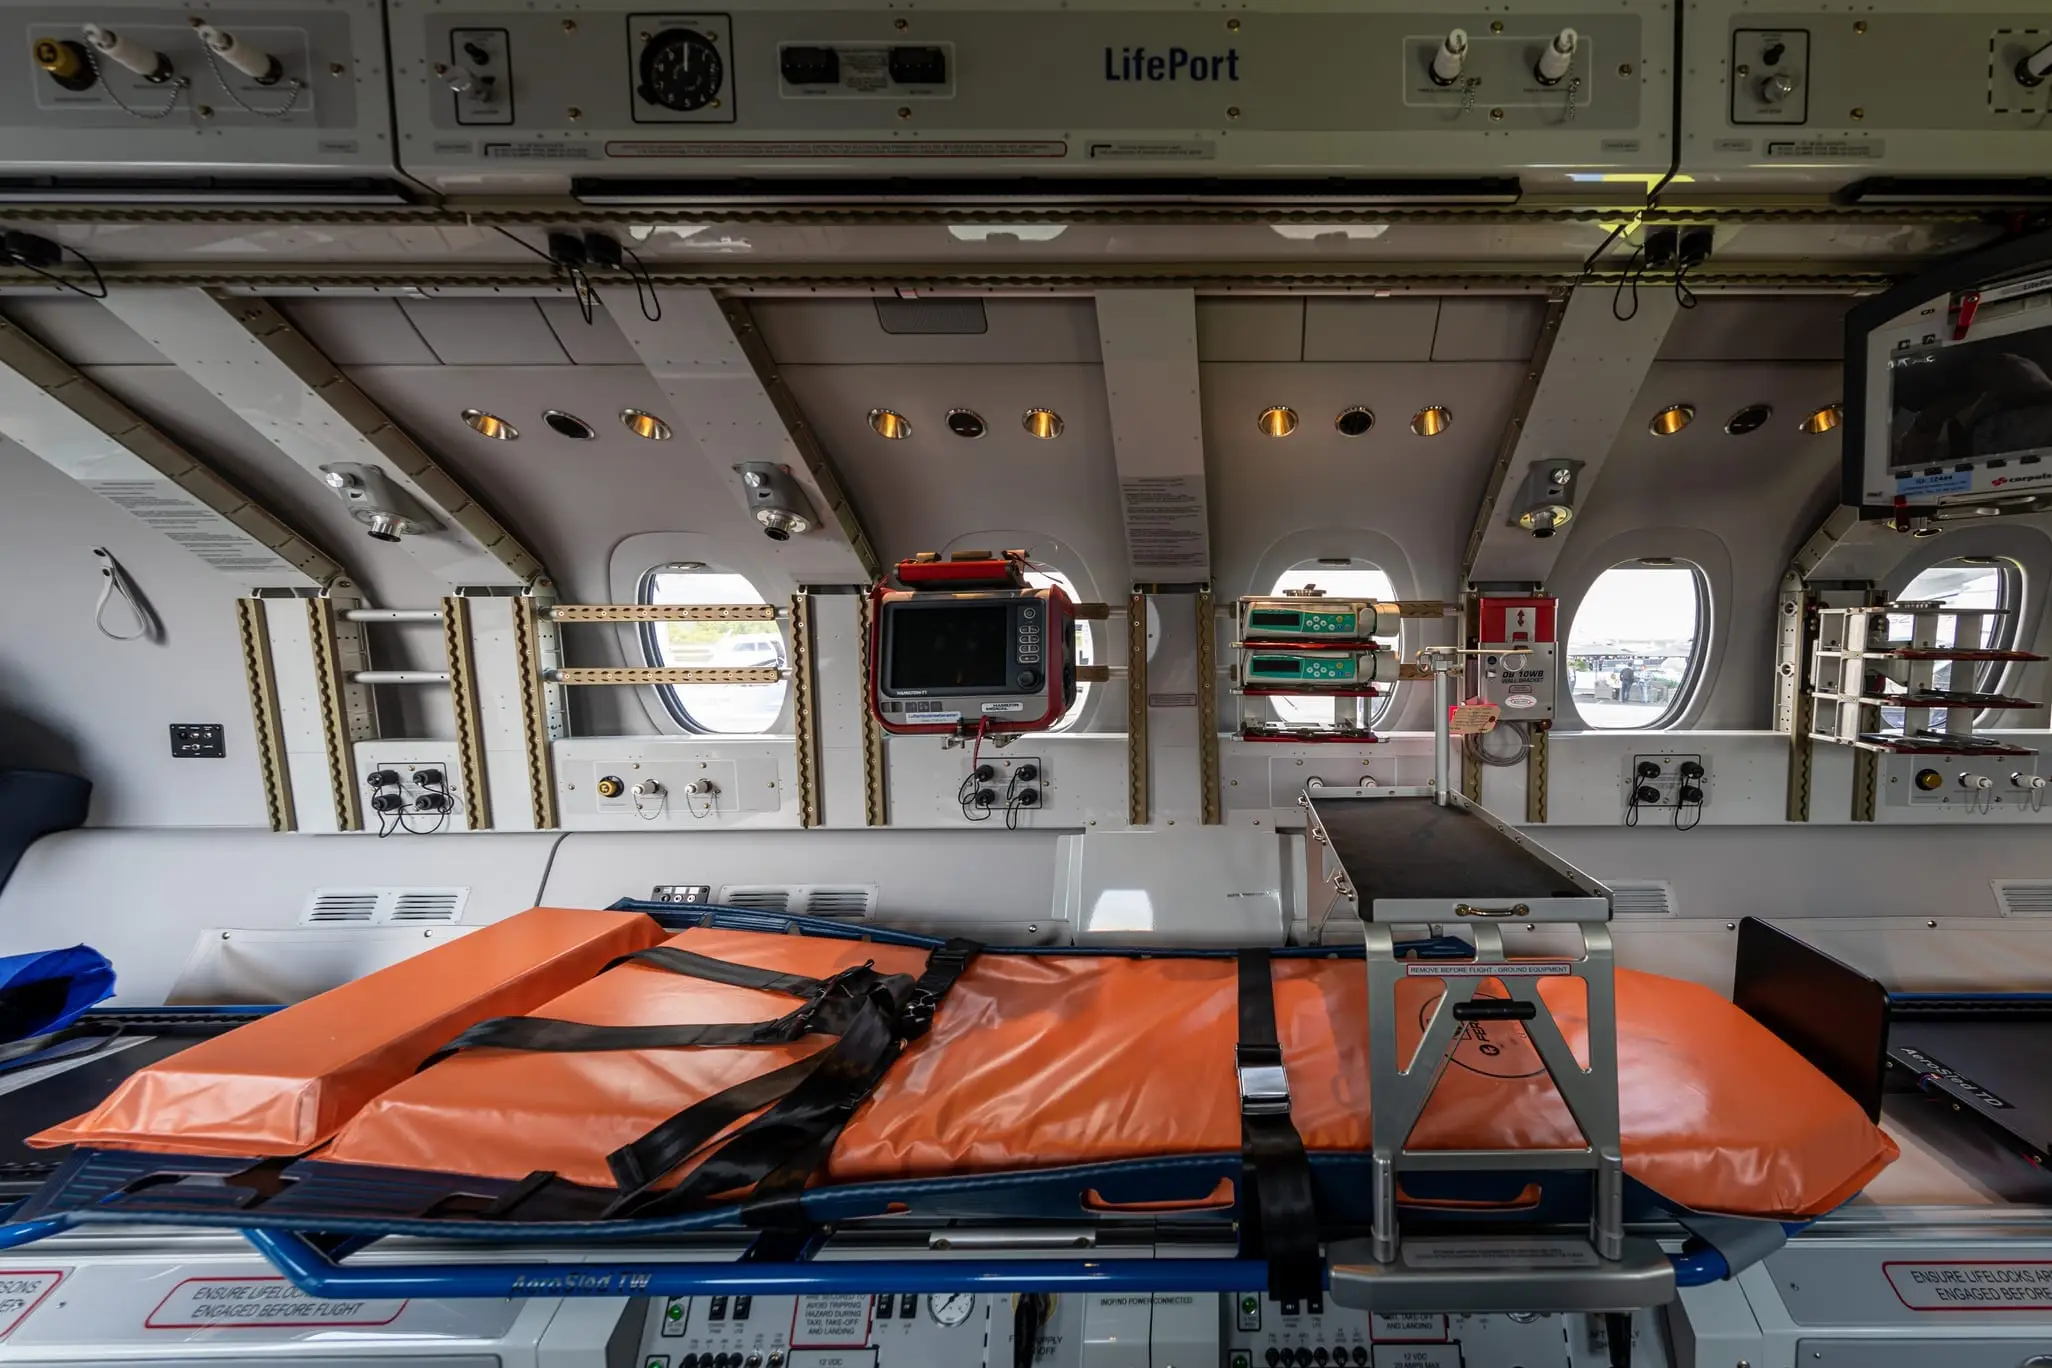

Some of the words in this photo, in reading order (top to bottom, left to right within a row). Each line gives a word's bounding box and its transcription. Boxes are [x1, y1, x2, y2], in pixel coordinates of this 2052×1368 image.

[1104, 46, 1239, 83] LifePort
[1899, 1047, 1979, 1091] AeroSled
[1976, 1091, 2005, 1110] TD
[511, 1272, 614, 1295] AeroSled
[617, 1271, 653, 1293] TW
[1910, 1269, 1966, 1284] ENSURE
[1965, 1269, 2036, 1284] LIFELOCKS
[192, 1286, 247, 1300] ENSURE
[1935, 1287, 2001, 1301] ENGAGED
[1999, 1287, 2052, 1301] BEFORE
[806, 1301, 828, 1309] AVOID
[829, 1301, 862, 1309] TRIPPING
[1129, 1297, 1153, 1306] POWER
[1154, 1296, 1193, 1305] CONNECTED
[190, 1303, 259, 1318] ENGAGED
[257, 1303, 314, 1317] BEFORE
[313, 1302, 366, 1316] FLIGHT
[825, 1318, 860, 1326] TAKE-OFF
[1386, 1322, 1401, 1330] AND
[1402, 1322, 1433, 1330] LANDING
[808, 1327, 823, 1335] AND
[824, 1327, 855, 1335] LANDING
[828, 1358, 843, 1366] VDC
